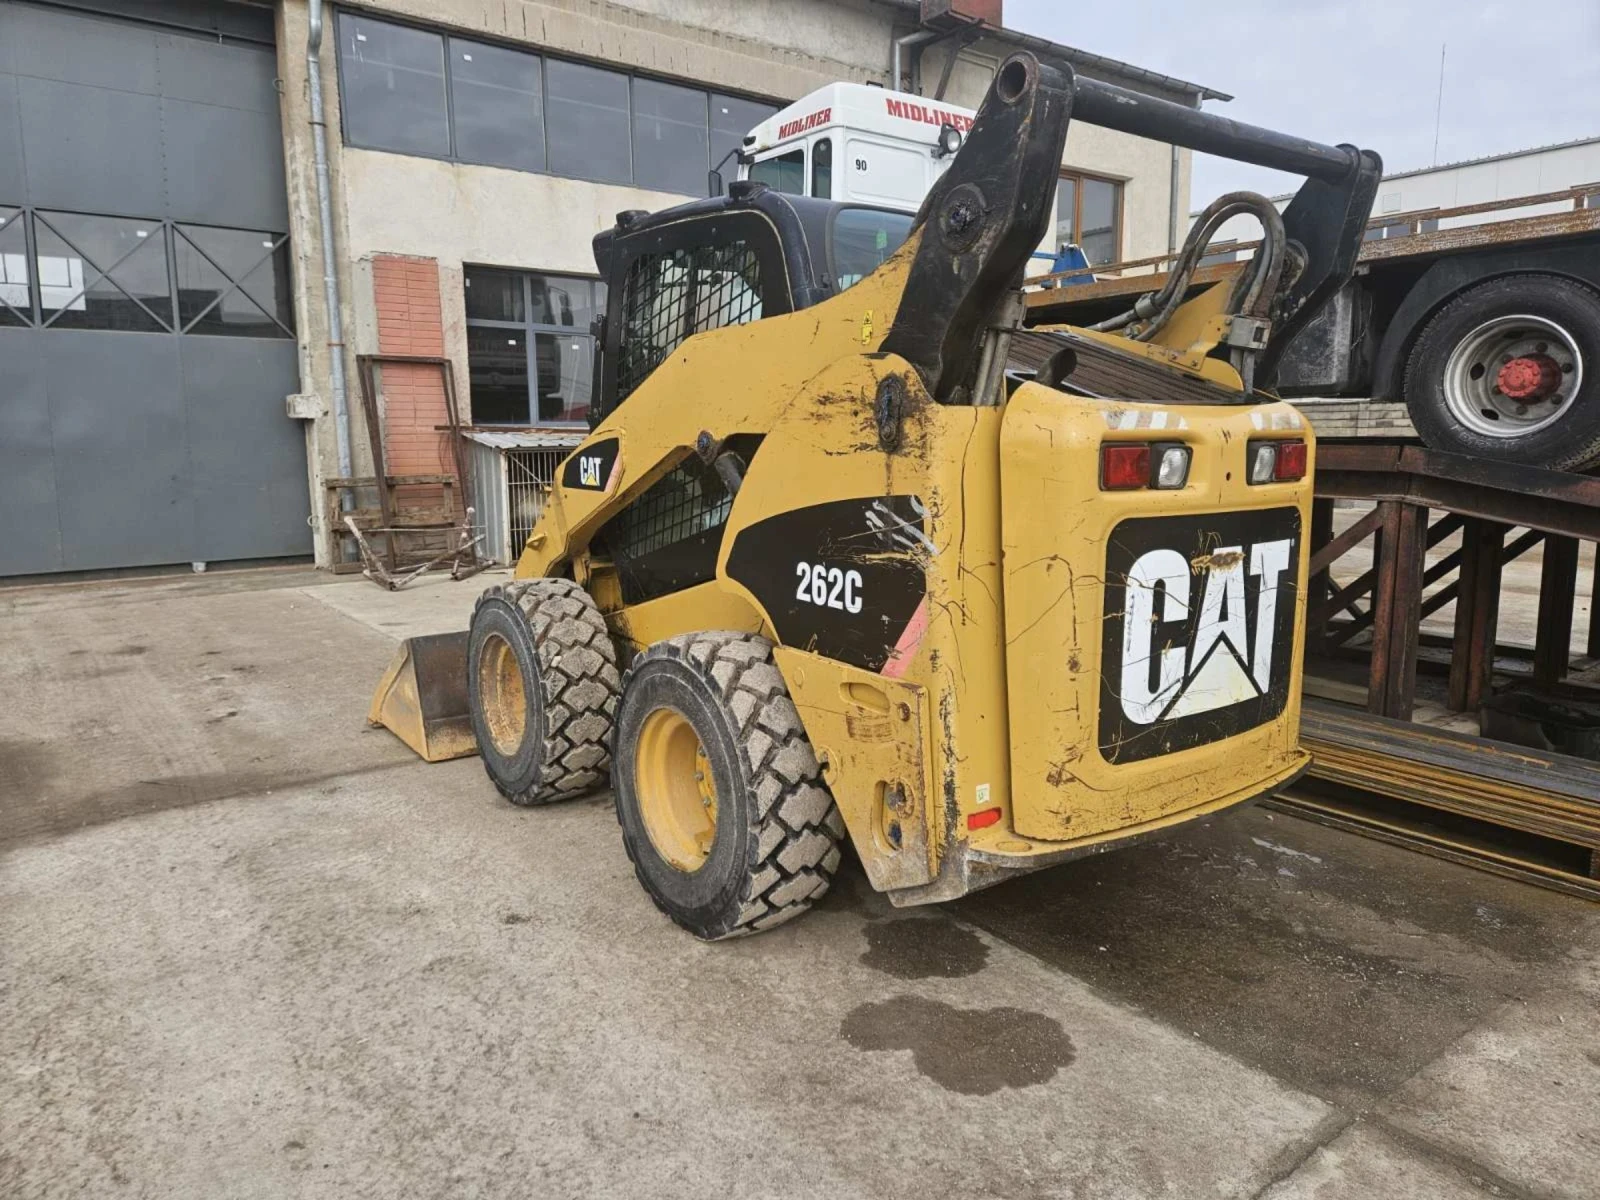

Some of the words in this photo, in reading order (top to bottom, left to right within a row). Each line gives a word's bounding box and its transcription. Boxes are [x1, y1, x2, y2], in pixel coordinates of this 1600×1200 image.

[778, 108, 831, 139] MIDLINER
[855, 159, 867, 171] 90
[580, 456, 601, 486] CAT
[796, 561, 863, 614] 262C
[1120, 539, 1290, 725] CAT
